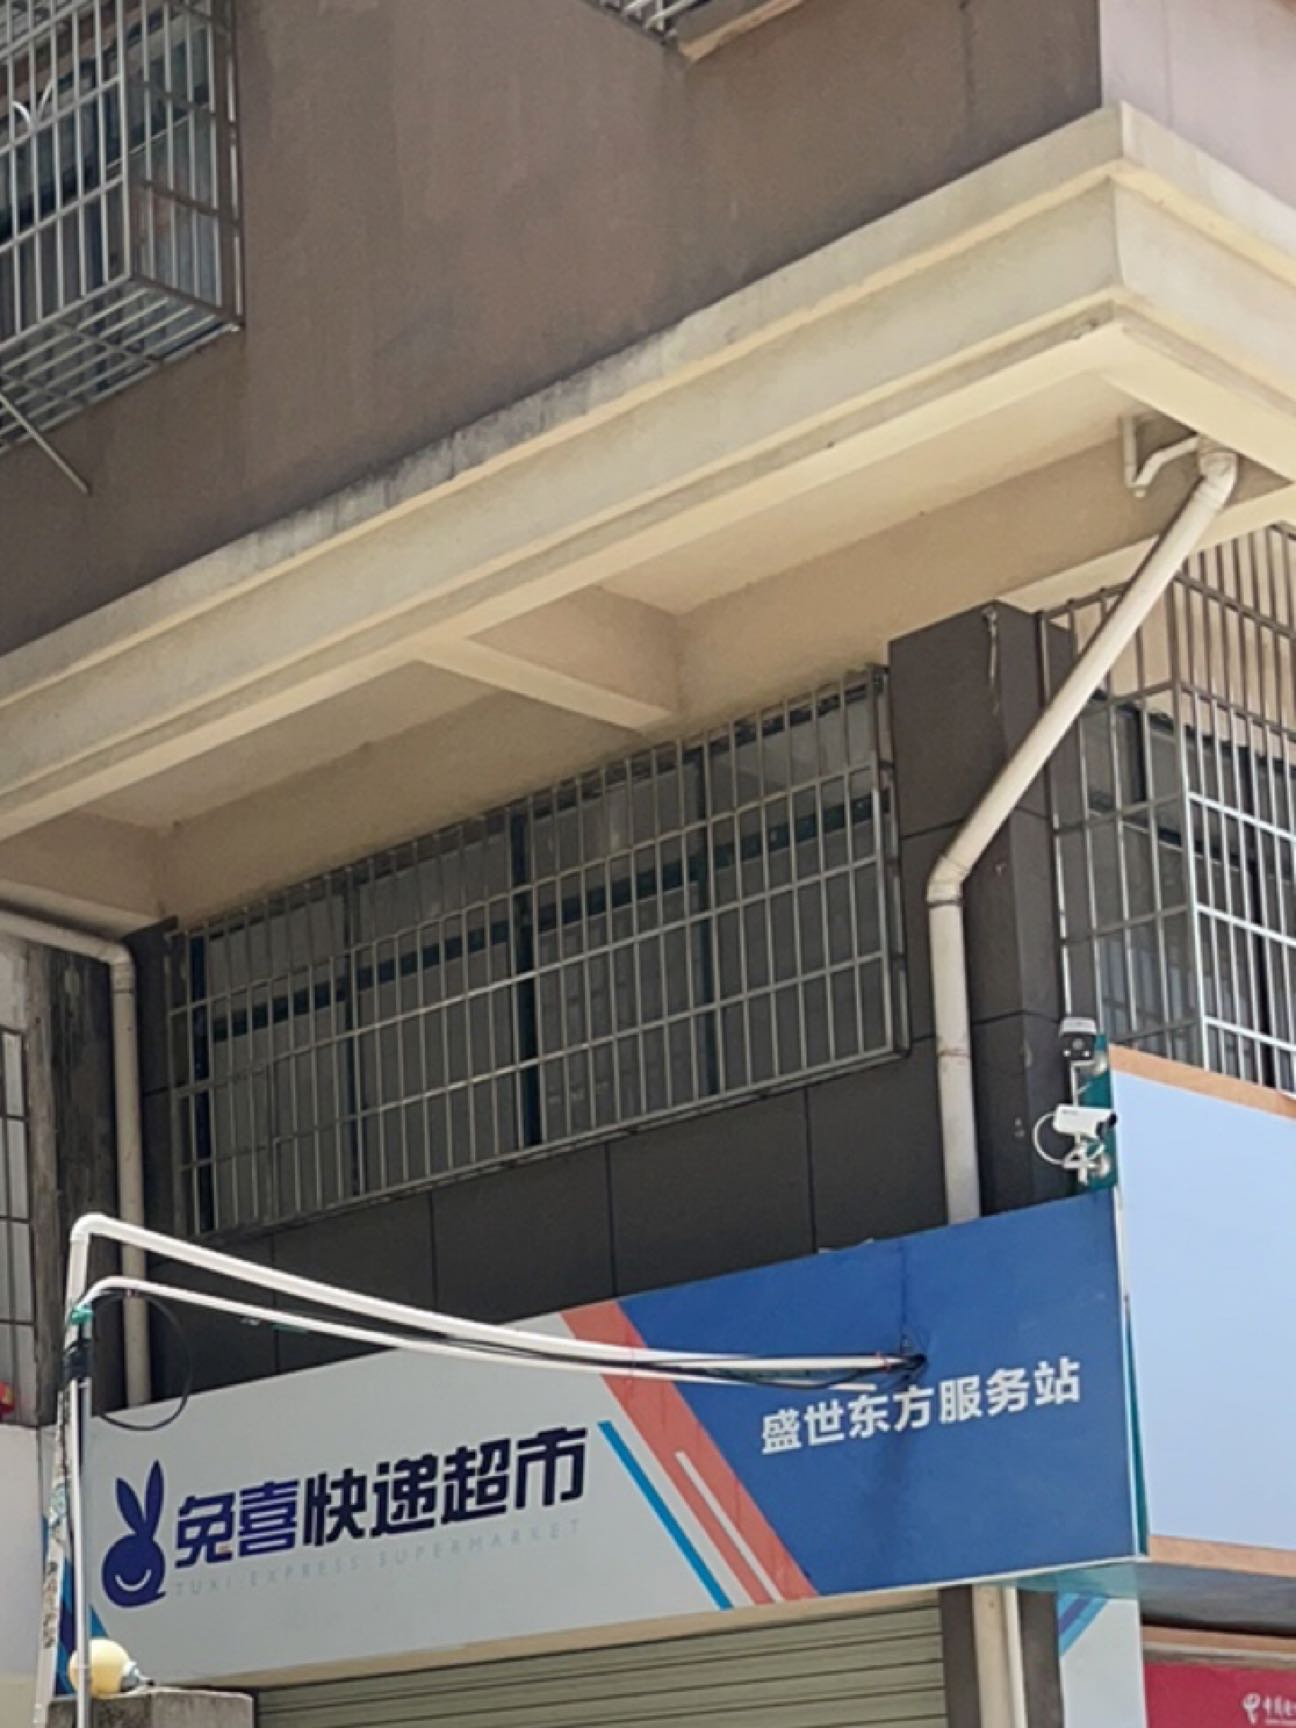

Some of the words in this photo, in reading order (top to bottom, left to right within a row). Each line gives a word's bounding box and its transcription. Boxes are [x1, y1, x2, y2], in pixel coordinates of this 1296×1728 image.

[761, 1355, 1080, 1454] 盛世东方服务站
[251, 1556, 361, 1587] EXPRESS
[379, 1518, 581, 1569] SUPERMARKET
